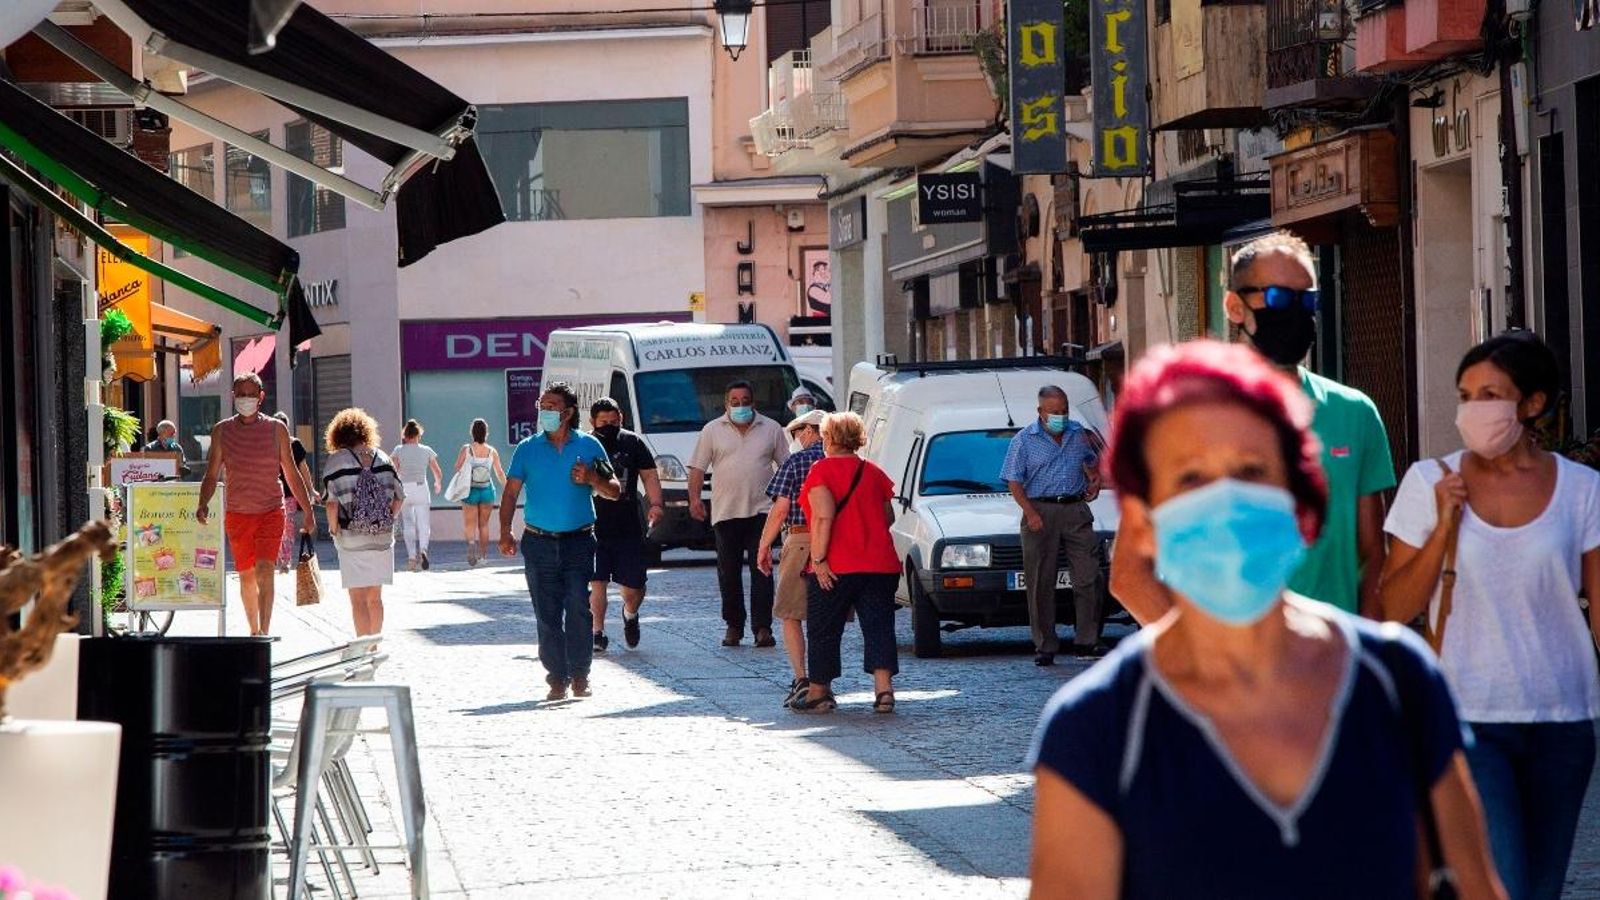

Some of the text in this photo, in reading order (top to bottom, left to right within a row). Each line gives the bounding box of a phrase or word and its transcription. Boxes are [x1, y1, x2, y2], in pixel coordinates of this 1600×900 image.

[1018, 21, 1059, 141] os
[1102, 0, 1139, 169] rio
[922, 183, 975, 200] YSISI
[932, 208, 967, 217] woman
[100, 279, 142, 306] danca
[644, 343, 772, 362] CARLOS ARRANZ
